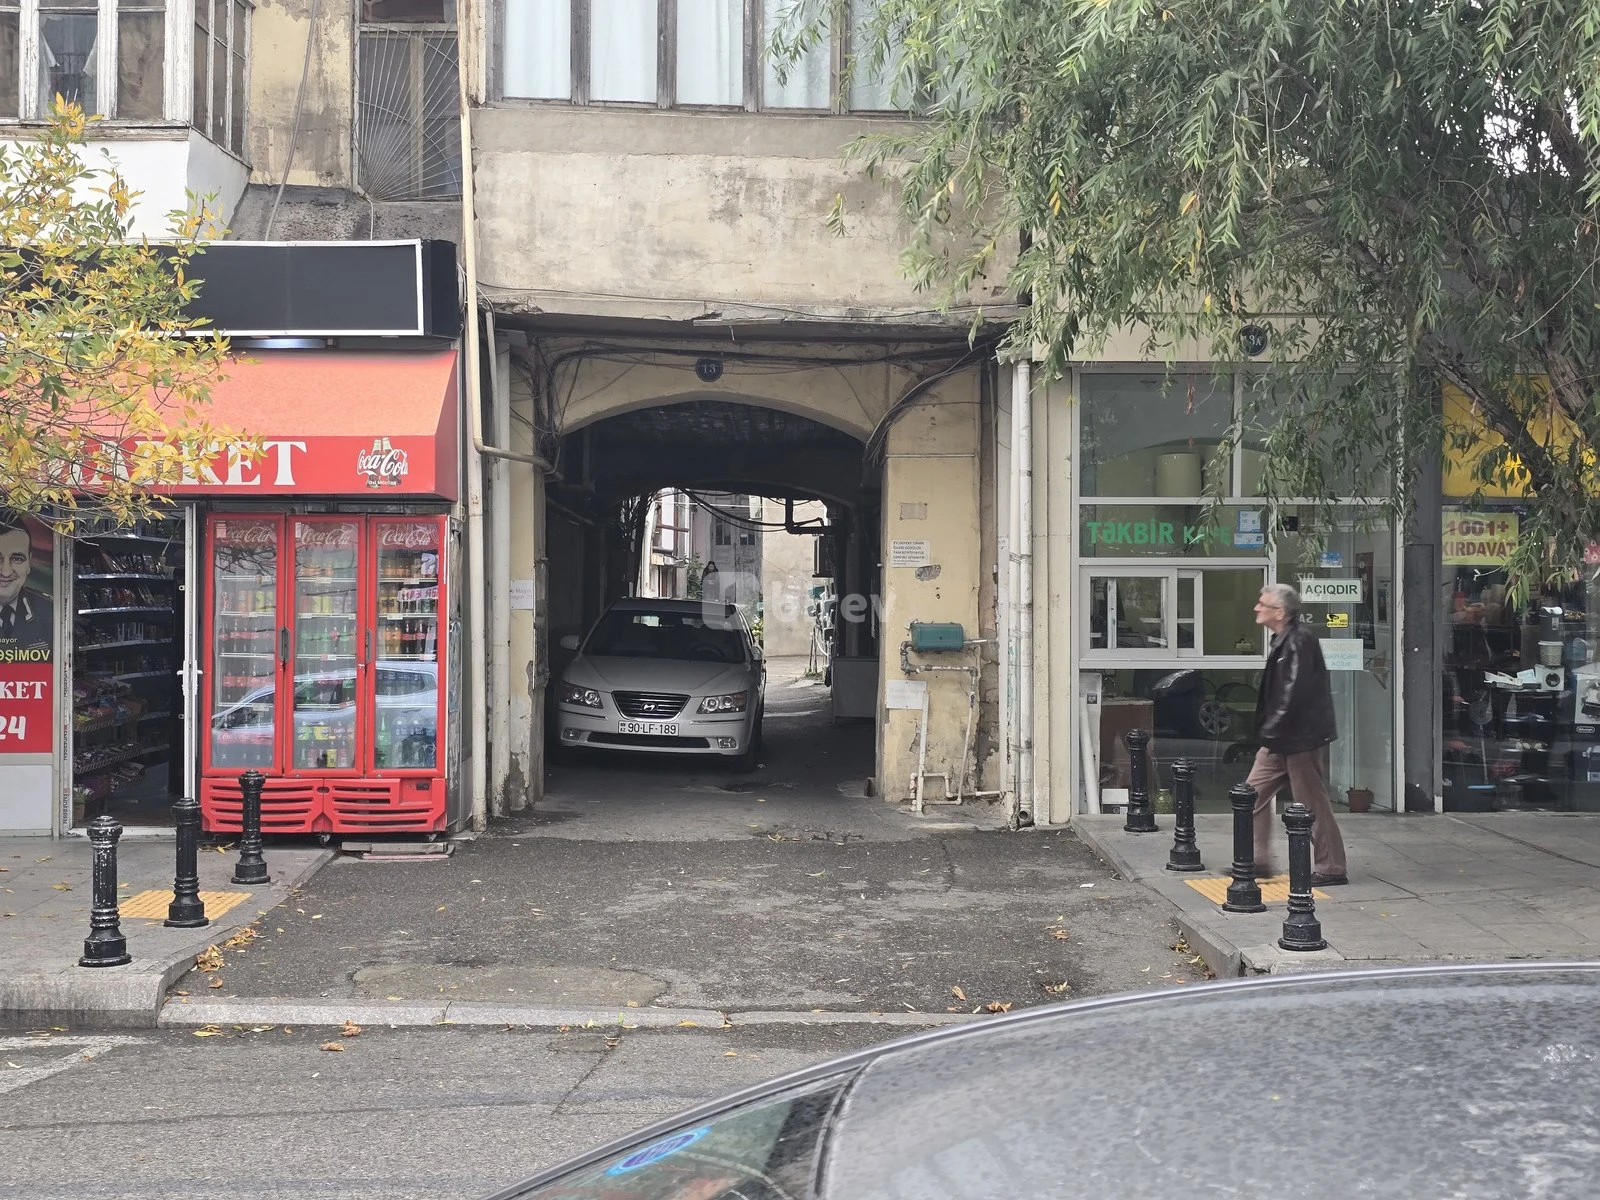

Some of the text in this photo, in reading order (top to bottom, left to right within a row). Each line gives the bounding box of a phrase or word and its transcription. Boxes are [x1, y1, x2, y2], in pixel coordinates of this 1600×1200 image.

[356, 448, 409, 477] Coca-Cola
[220, 526, 271, 544] oca-Cola
[302, 528, 352, 545] Coca-Cola
[1086, 518, 1175, 545] TƏKBİR
[1446, 520, 1509, 536] 1001+
[1305, 584, 1358, 597] AÇIQDIR
